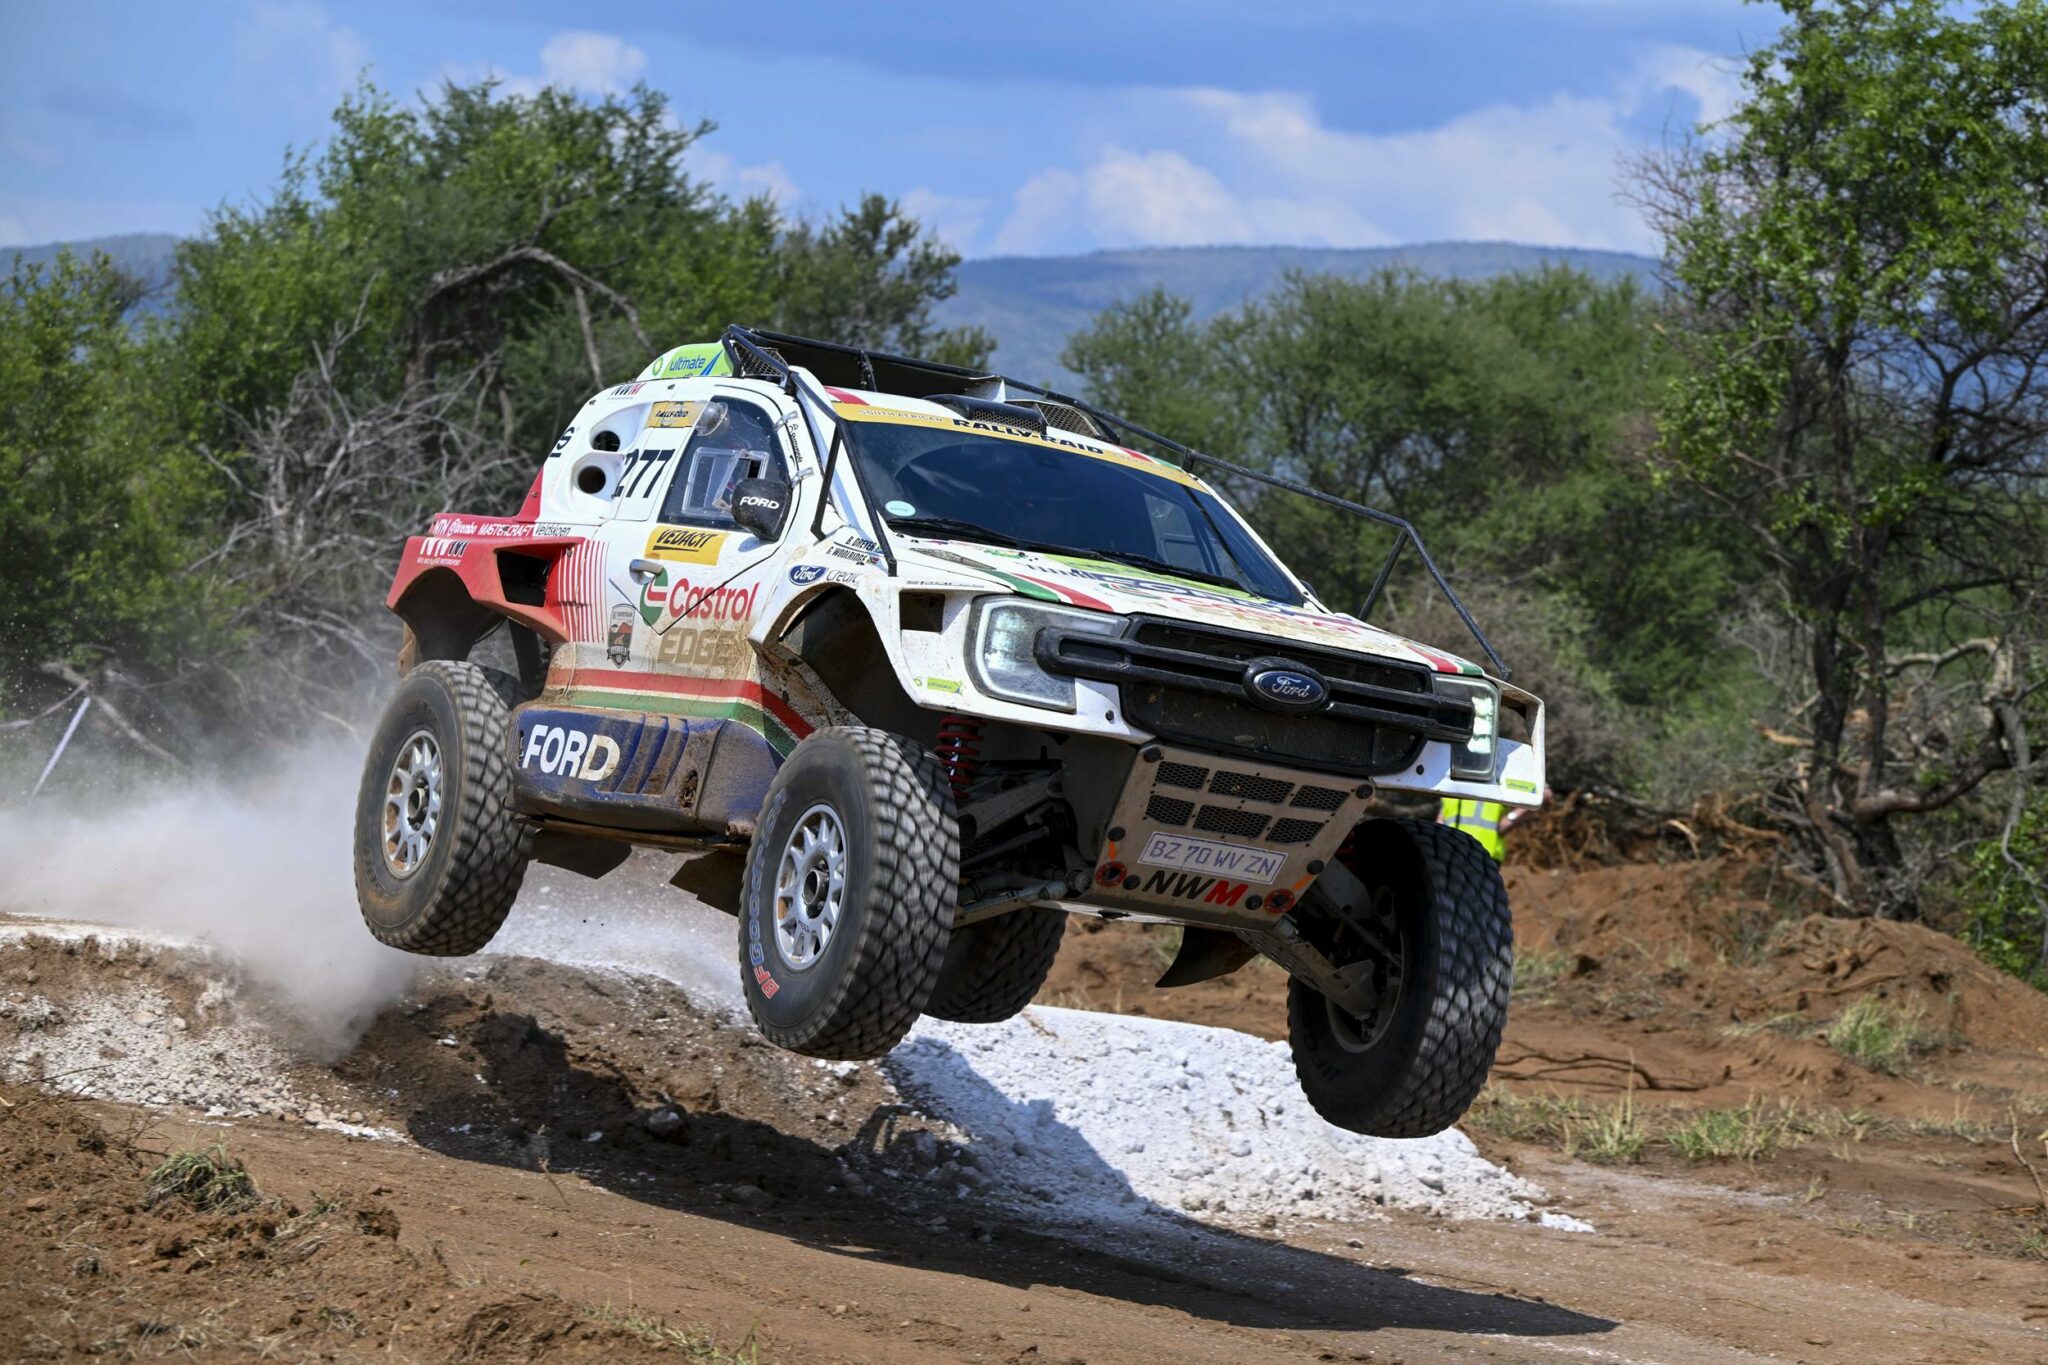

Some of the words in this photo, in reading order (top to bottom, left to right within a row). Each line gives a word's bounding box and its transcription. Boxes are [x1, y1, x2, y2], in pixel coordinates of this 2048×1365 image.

[669, 355, 706, 372] ultimate
[952, 418, 1105, 455] RALLY-RAID
[611, 448, 676, 499] 277
[739, 496, 780, 510] FORD
[477, 523, 535, 537] MASTERCRAFT
[852, 538, 877, 552] DREYER
[419, 536, 471, 558] NWM
[832, 547, 868, 564] WOOLRIDGE
[668, 577, 761, 622] Castrol
[656, 627, 739, 666] EDGE
[1271, 675, 1311, 699] Ford
[521, 723, 621, 782] FORD
[1149, 840, 1182, 861] BZ
[1182, 845, 1212, 865] 70
[1212, 851, 1243, 870] WV
[1243, 856, 1277, 877] ZN
[1142, 870, 1249, 907] NWM
